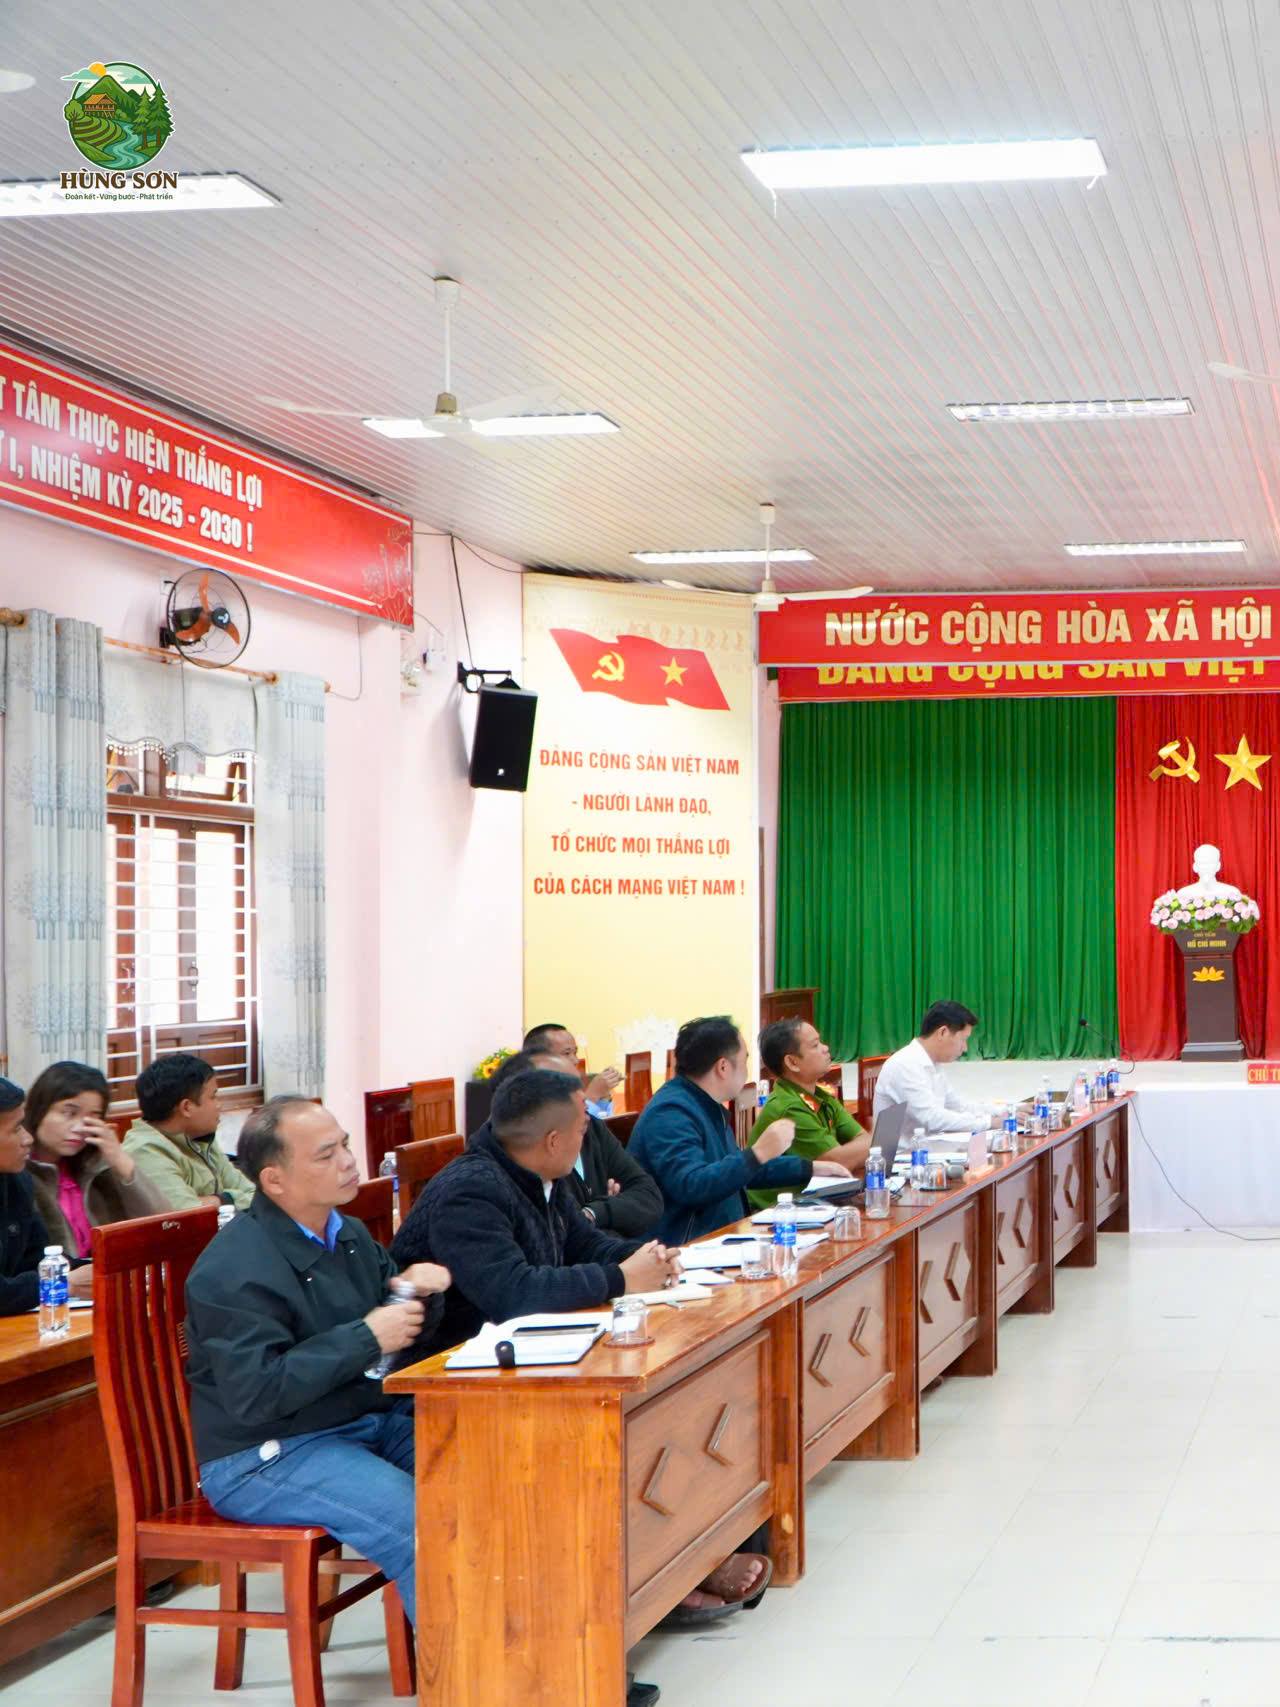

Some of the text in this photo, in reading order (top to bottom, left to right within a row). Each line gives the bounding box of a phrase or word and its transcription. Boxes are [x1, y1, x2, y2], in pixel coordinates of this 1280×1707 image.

[12, 381, 60, 431] TÂM
[67, 403, 119, 455] THỰC
[125, 427, 170, 474] HIỆN
[175, 445, 232, 496] THẮNG
[237, 470, 262, 511] LỢI
[10, 437, 24, 479] I,
[32, 446, 101, 500] NHIỆM
[107, 470, 133, 511] KỲ
[138, 484, 182, 528] 2025
[200, 507, 242, 548] 2030
[247, 522, 253, 552] !
[826, 602, 929, 646] NƯỚC
[941, 602, 1041, 652] CỘNG
[1057, 601, 1131, 644] HÒA
[1146, 599, 1199, 642] XÃ
[1212, 597, 1271, 648] HỘI
[540, 745, 740, 776] ĐẢNG CỘNG SẢN VIỆT NAM
[583, 791, 712, 818] NGƯỜI LÃNH ĐẠO,
[552, 828, 730, 859] TỔ CHỨC MỌI THẮNG LỢI
[534, 872, 744, 900] CỦA CÁCH MẠNG VIỆT NAM !
